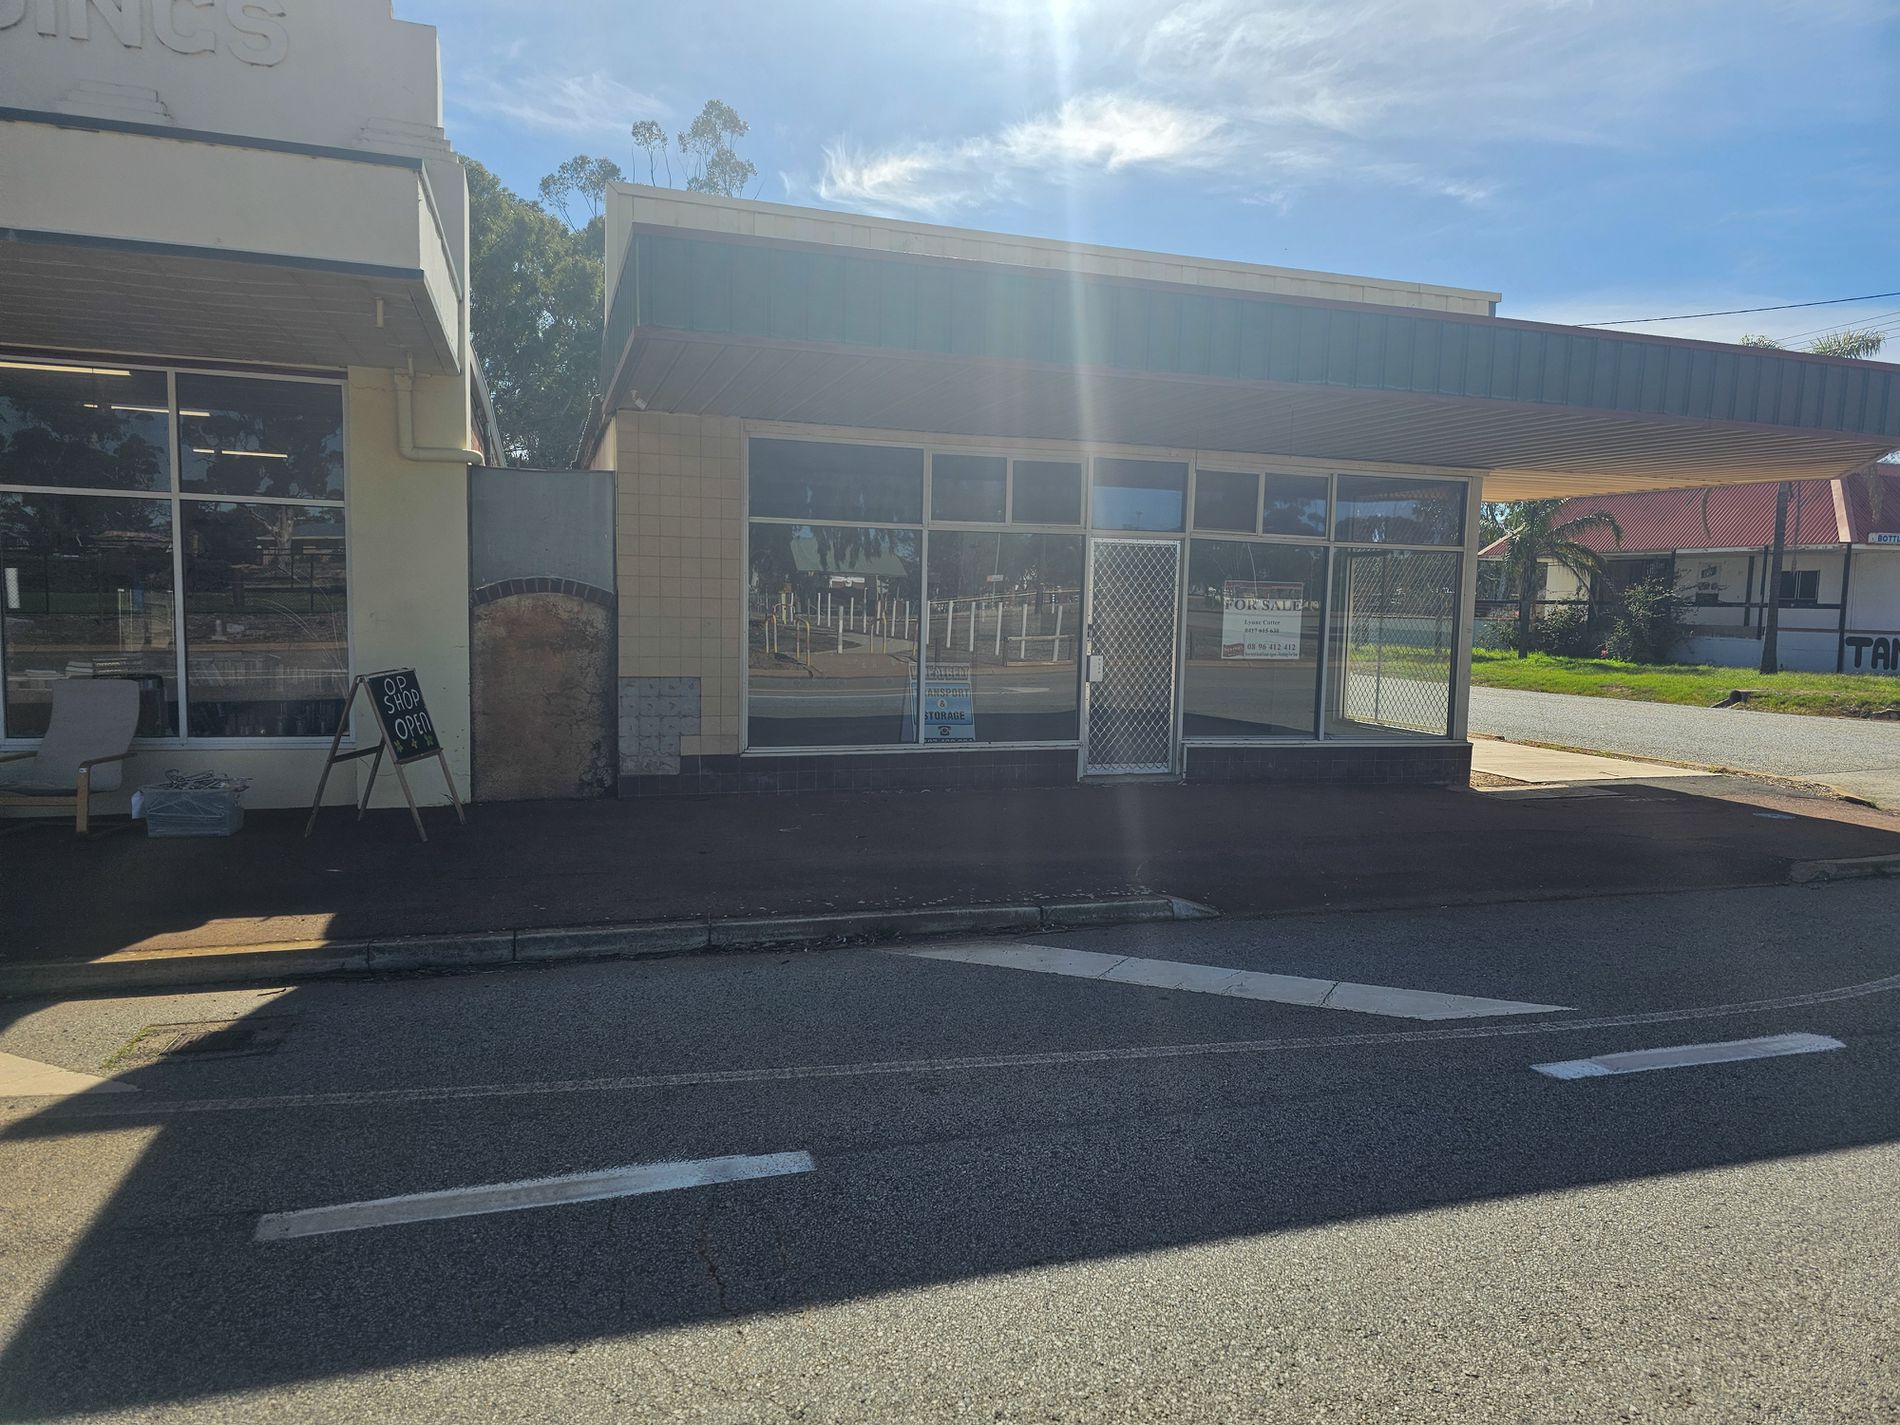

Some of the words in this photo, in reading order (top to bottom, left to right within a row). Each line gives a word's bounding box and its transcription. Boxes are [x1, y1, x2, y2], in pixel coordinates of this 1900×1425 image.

[1225, 599, 1257, 611] FOR
[1261, 599, 1302, 612] SALE
[1269, 643, 1281, 651] 412
[384, 675, 407, 695] OP
[383, 689, 420, 714] SHOP
[939, 700, 946, 708] &
[395, 711, 432, 740] OPEN
